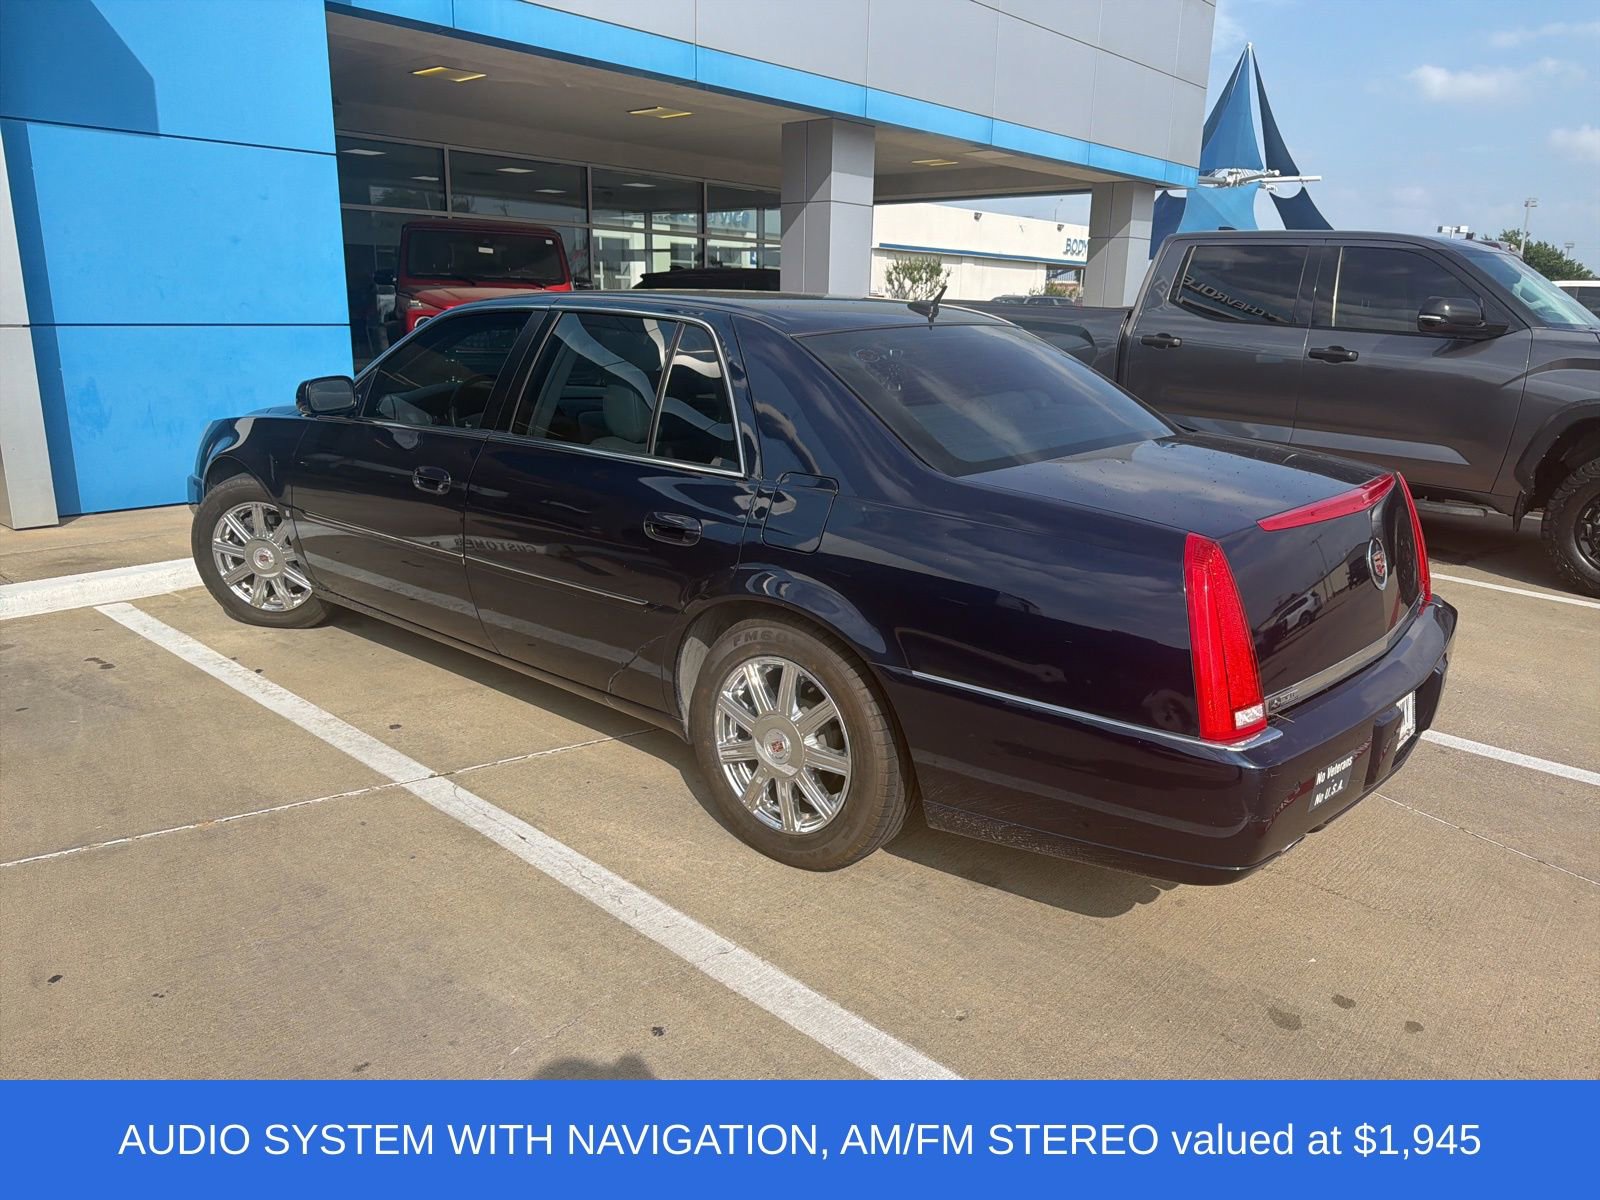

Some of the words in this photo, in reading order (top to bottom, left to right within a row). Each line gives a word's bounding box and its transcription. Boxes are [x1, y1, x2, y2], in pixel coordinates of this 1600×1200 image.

[1315, 771, 1326, 786] No
[1327, 756, 1353, 779] Veterans
[1314, 792, 1325, 806] No
